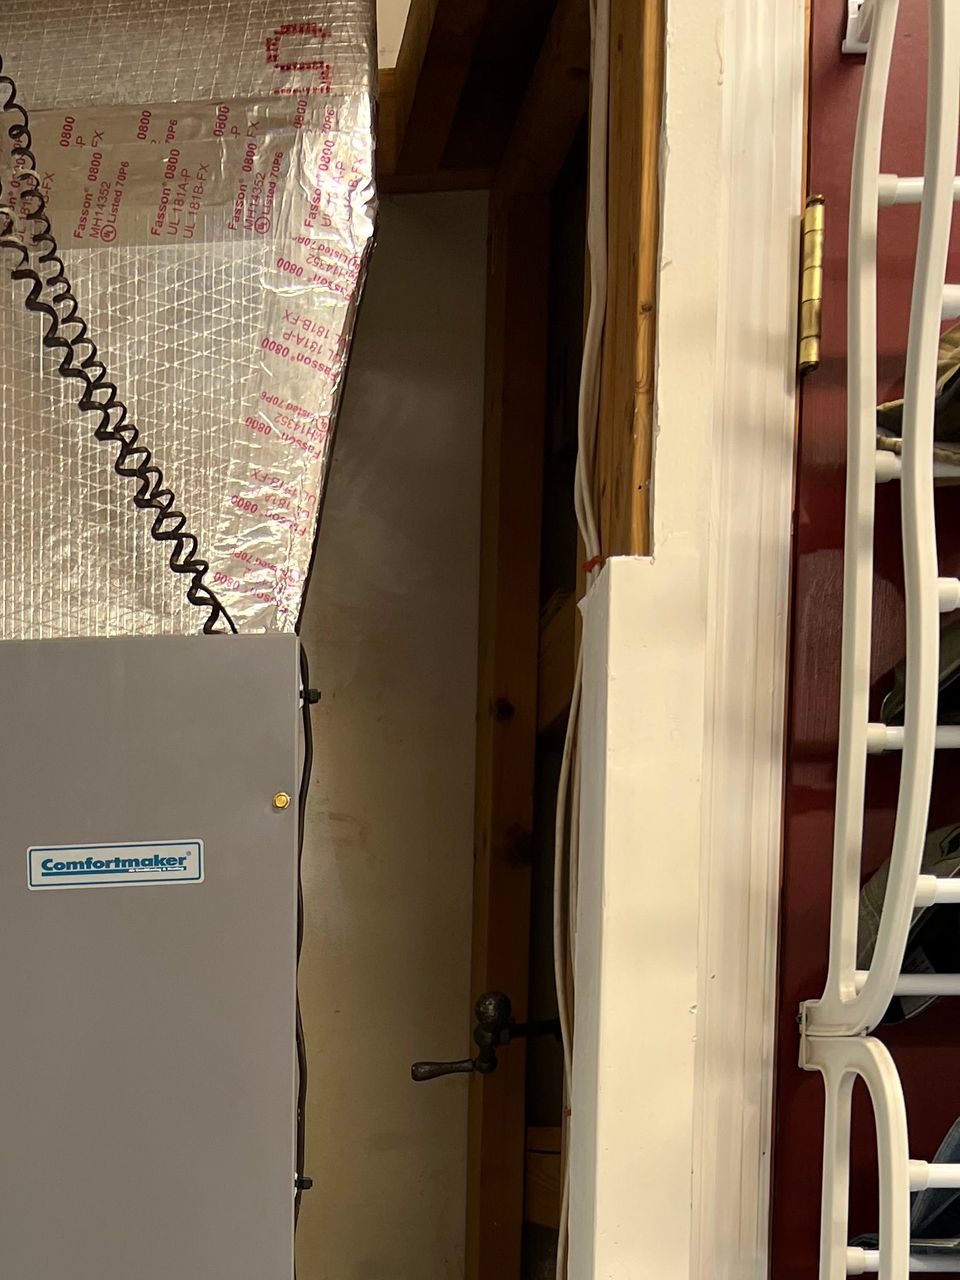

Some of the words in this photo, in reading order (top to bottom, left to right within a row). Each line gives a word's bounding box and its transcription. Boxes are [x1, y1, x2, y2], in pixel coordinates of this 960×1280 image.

[137, 110, 151, 140] 0800
[213, 106, 230, 137] 0800
[293, 100, 307, 128] 0800
[60, 116, 75, 147] 0800
[319, 140, 335, 171] 0800
[74, 193, 93, 238] Fasson
[88, 152, 103, 182] 0800
[107, 190, 122, 224] Listed
[116, 161, 130, 187] 70P6
[151, 188, 171, 236] Fasson
[165, 149, 180, 179] 0800
[173, 168, 190, 212] 181A-P
[228, 184, 247, 230] Fasson
[242, 143, 257, 172] 0800
[263, 181, 276, 215] Listed
[271, 152, 283, 181] 70P6
[90, 181, 112, 238] MH14352
[183, 223, 195, 239] UL
[189, 163, 209, 215] 181B-FX
[244, 172, 266, 231] MH14352
[167, 218, 180, 236] UL
[277, 257, 304, 278] 0800
[282, 310, 330, 339] 181B-FX
[261, 337, 289, 358] 0800
[283, 330, 324, 355] 181A-P
[297, 353, 340, 382] Fasson
[261, 391, 285, 408] 70P6
[245, 416, 272, 436] 0800
[273, 412, 325, 444] MH14352
[230, 494, 258, 515] 0800
